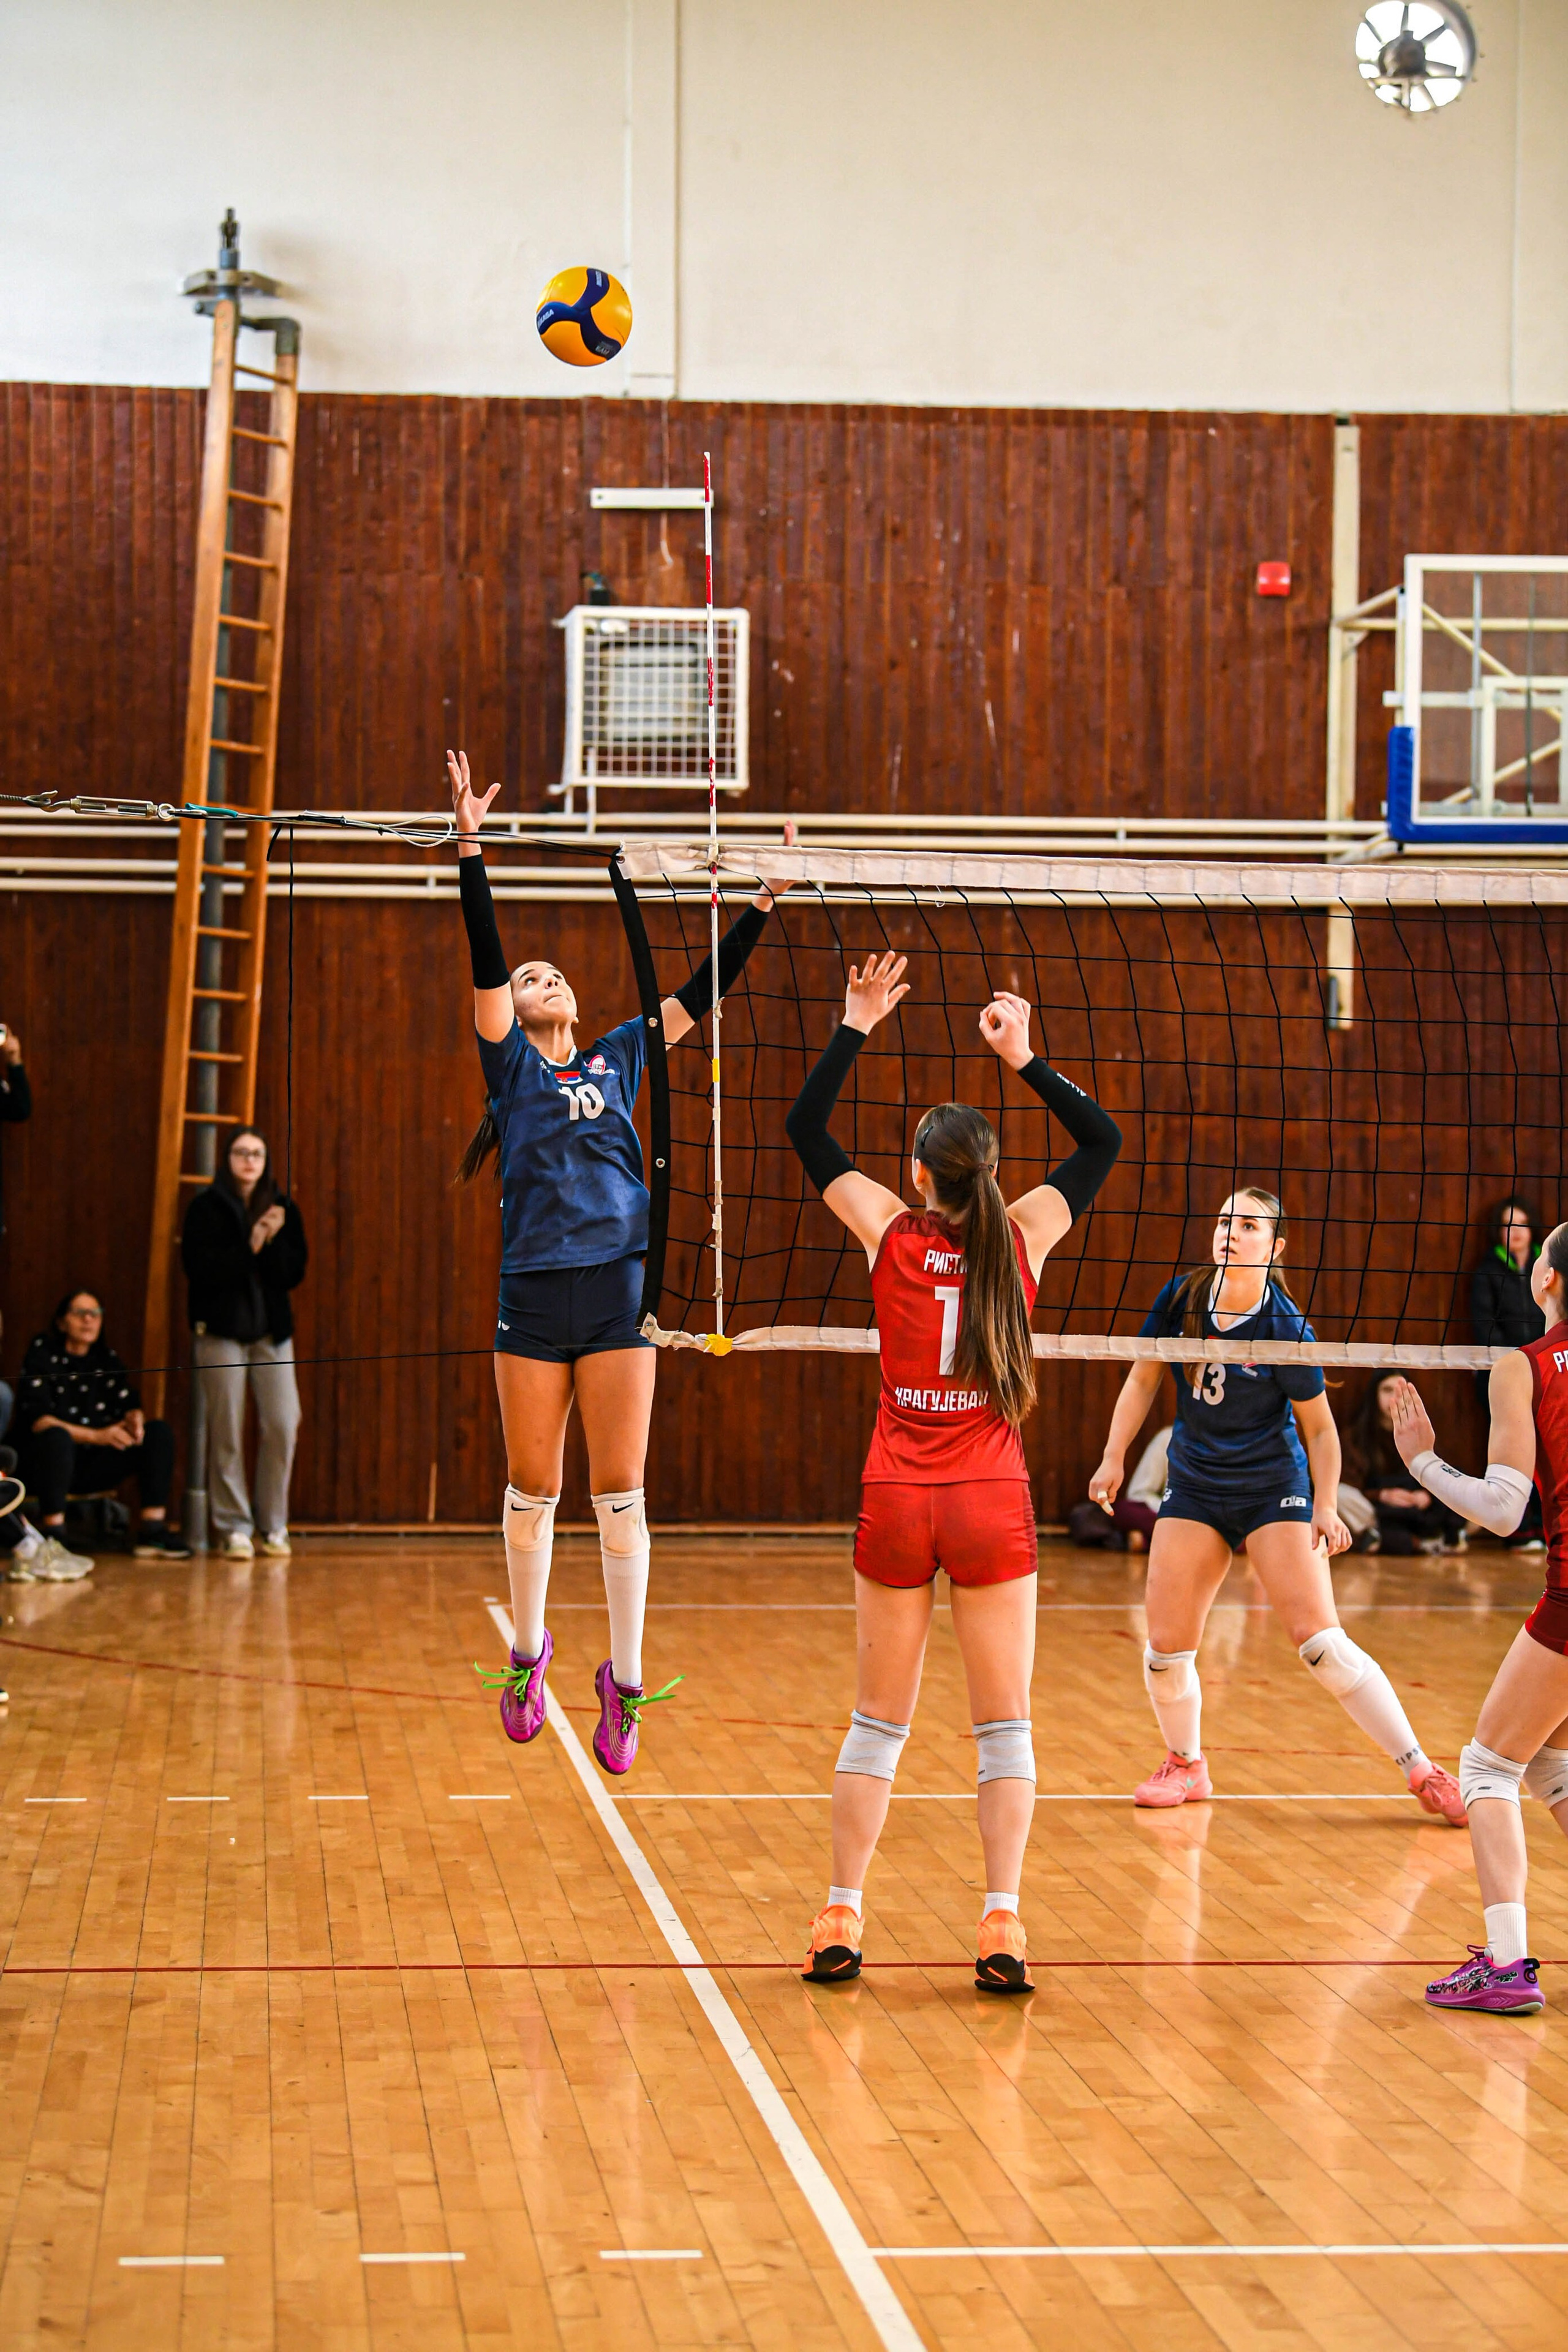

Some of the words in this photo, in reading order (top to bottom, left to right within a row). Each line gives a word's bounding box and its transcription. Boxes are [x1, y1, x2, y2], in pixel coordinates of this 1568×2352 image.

[559, 1083, 605, 1120] 10
[935, 1286, 960, 1376] 1
[1193, 1363, 1226, 1406] 13
